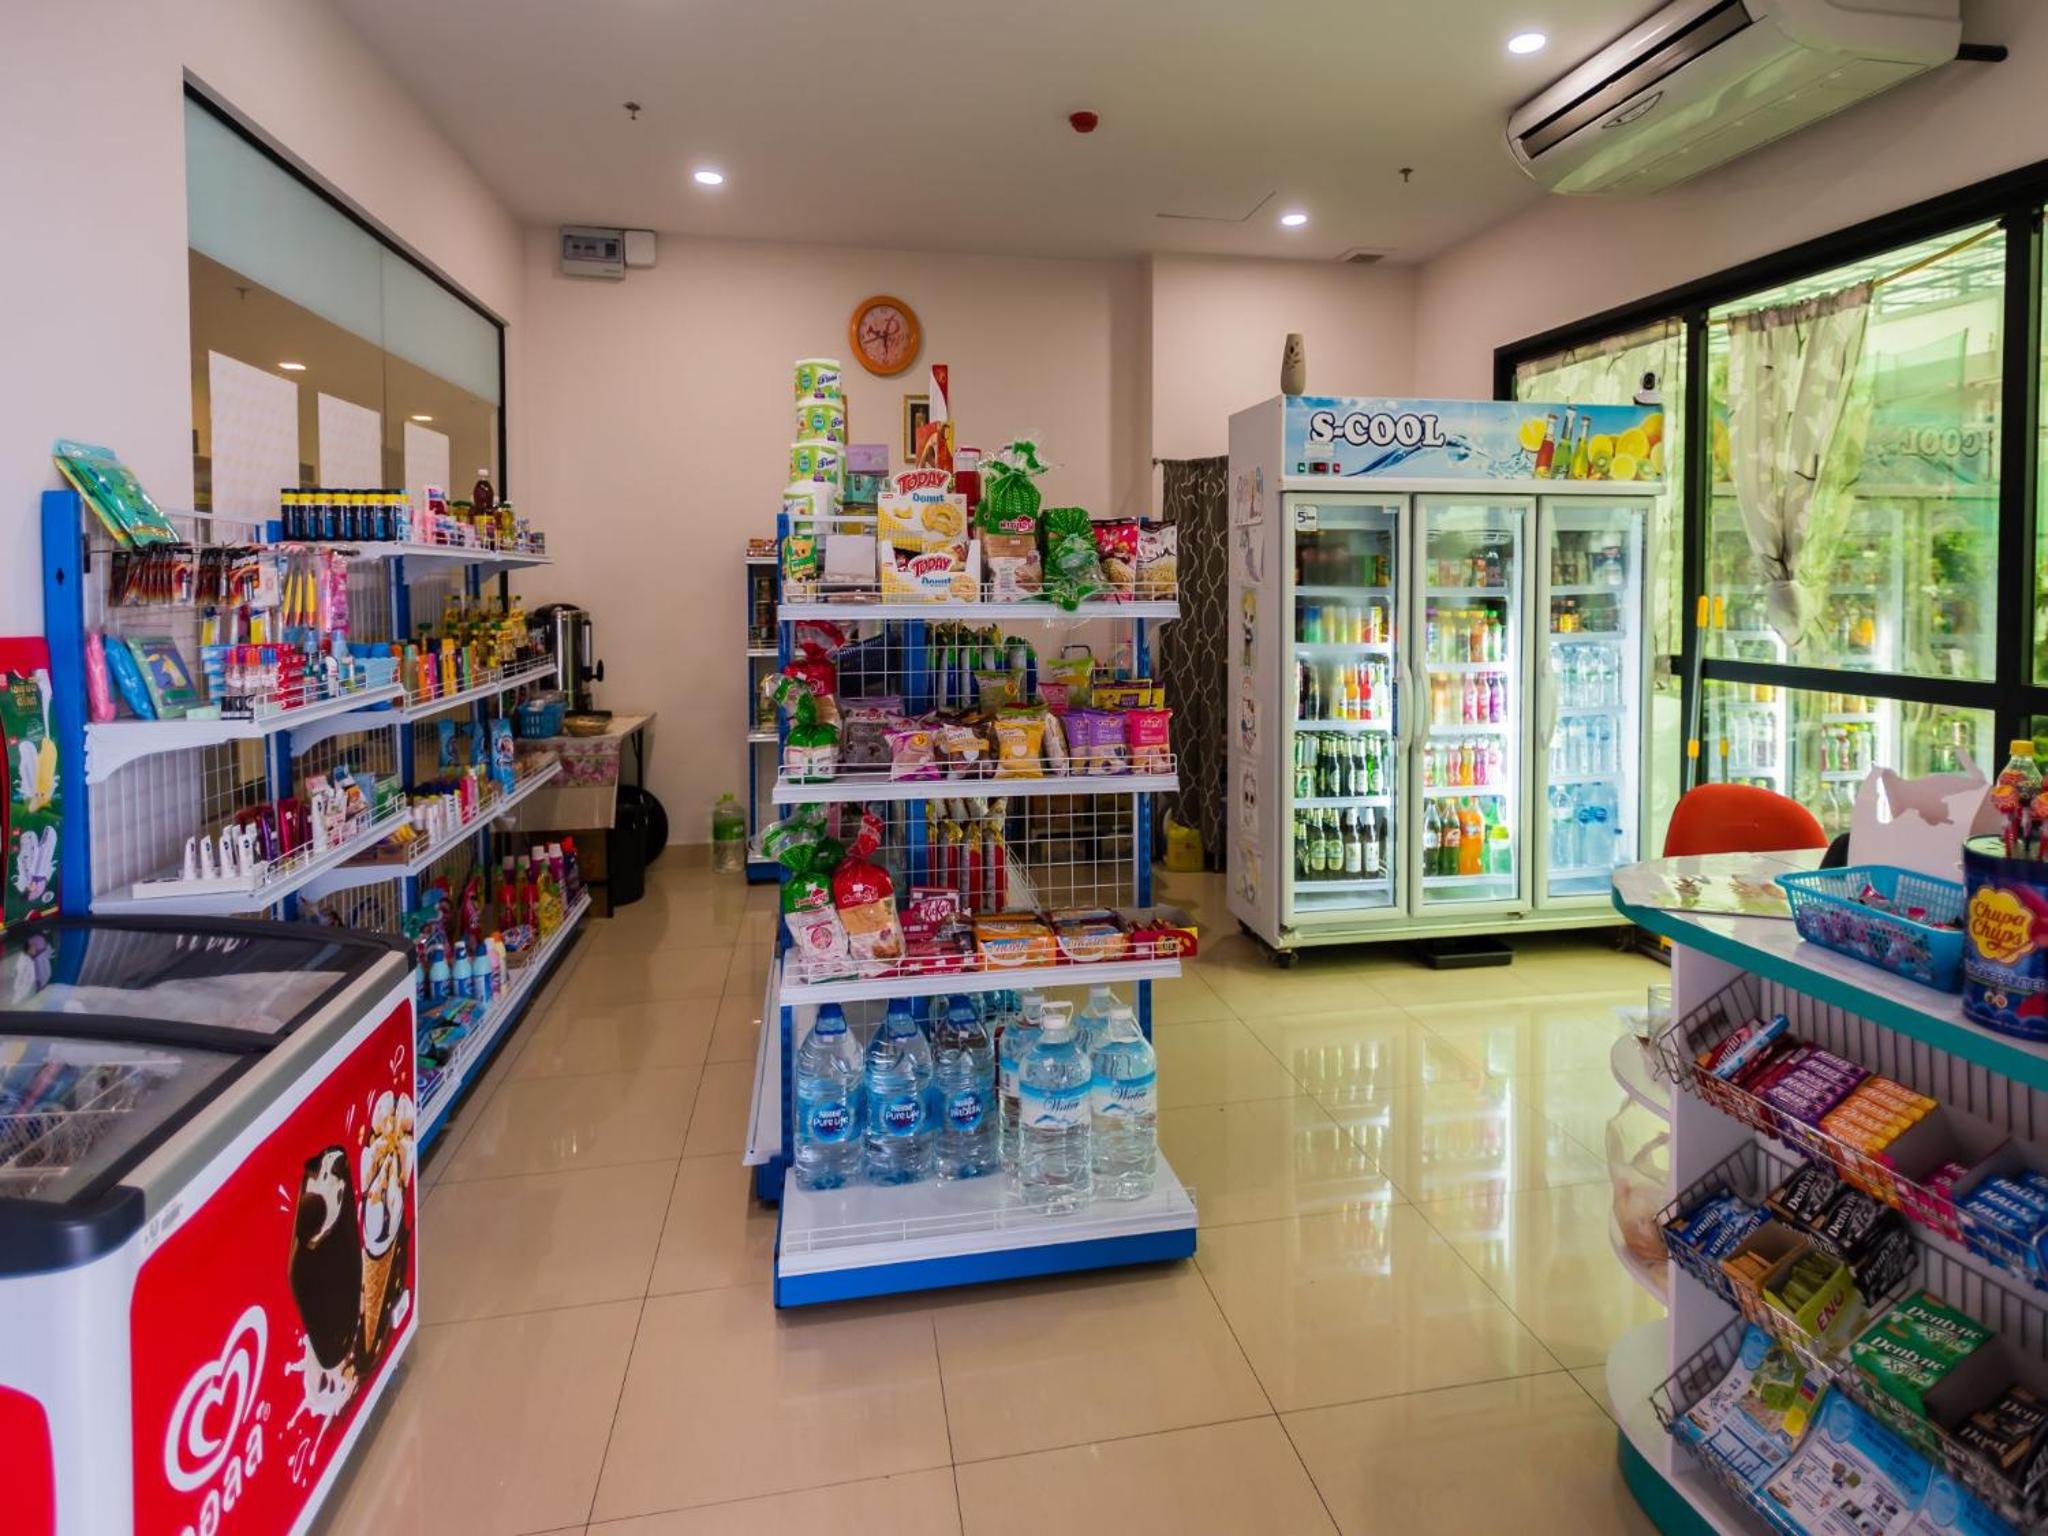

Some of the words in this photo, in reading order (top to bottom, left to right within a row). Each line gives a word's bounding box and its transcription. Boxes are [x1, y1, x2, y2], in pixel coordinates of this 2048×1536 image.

[1310, 411, 1446, 448] S-COOL
[897, 470, 948, 496] TODAY
[912, 493, 944, 503] Donut
[911, 557, 951, 577] TODAY
[1974, 901, 2026, 928] Chupa
[1972, 918, 2024, 947] Chups
[1979, 1189, 2031, 1216] HALLS
[1992, 1178, 2045, 1204] HALLS
[1966, 1201, 2018, 1227] HALLS
[1817, 1291, 1845, 1333] ENO
[1906, 1305, 1984, 1341] Dentyne
[1870, 1336, 1947, 1373] Dentyne
